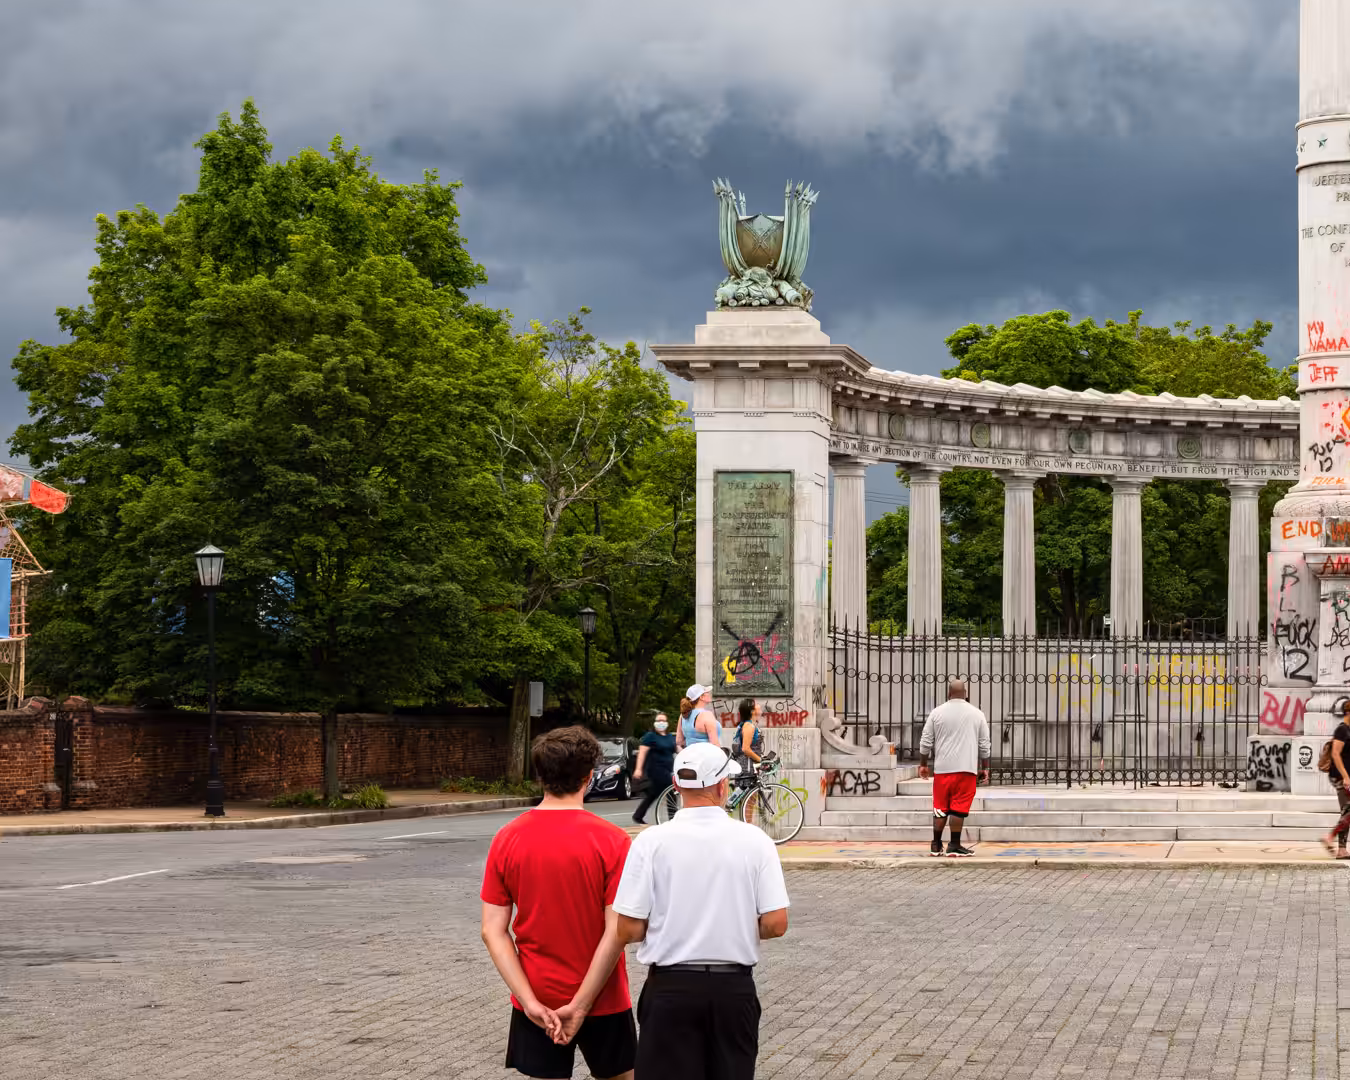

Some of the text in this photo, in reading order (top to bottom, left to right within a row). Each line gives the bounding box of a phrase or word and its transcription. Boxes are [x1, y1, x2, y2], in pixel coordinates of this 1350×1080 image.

[1301, 227, 1314, 239] THE
[1330, 242, 1346, 253] OF
[1307, 321, 1325, 339] MY
[1308, 363, 1339, 383] JEFF
[843, 441, 849, 450] TO
[885, 447, 911, 457] SECTION
[913, 450, 921, 458] OF
[924, 452, 936, 460] THE
[974, 456, 989, 464] NOT
[992, 456, 1012, 466] EVEN
[1014, 458, 1031, 467] FOR
[1033, 459, 1050, 468] OUR
[1053, 460, 1073, 469] OWN
[1075, 461, 1123, 472] PECUNIARY
[1171, 466, 1188, 474] BUT
[1192, 466, 1217, 475] FROM
[1221, 467, 1239, 476] THE
[1243, 468, 1267, 477] HIGH
[1270, 469, 1290, 477] AND
[1319, 456, 1333, 472] 12
[1281, 520, 1323, 540] END
[1281, 646, 1317, 684] 12
[762, 710, 809, 728] TRUMP
[1250, 740, 1292, 764] Trump
[828, 768, 881, 797] ACAB
